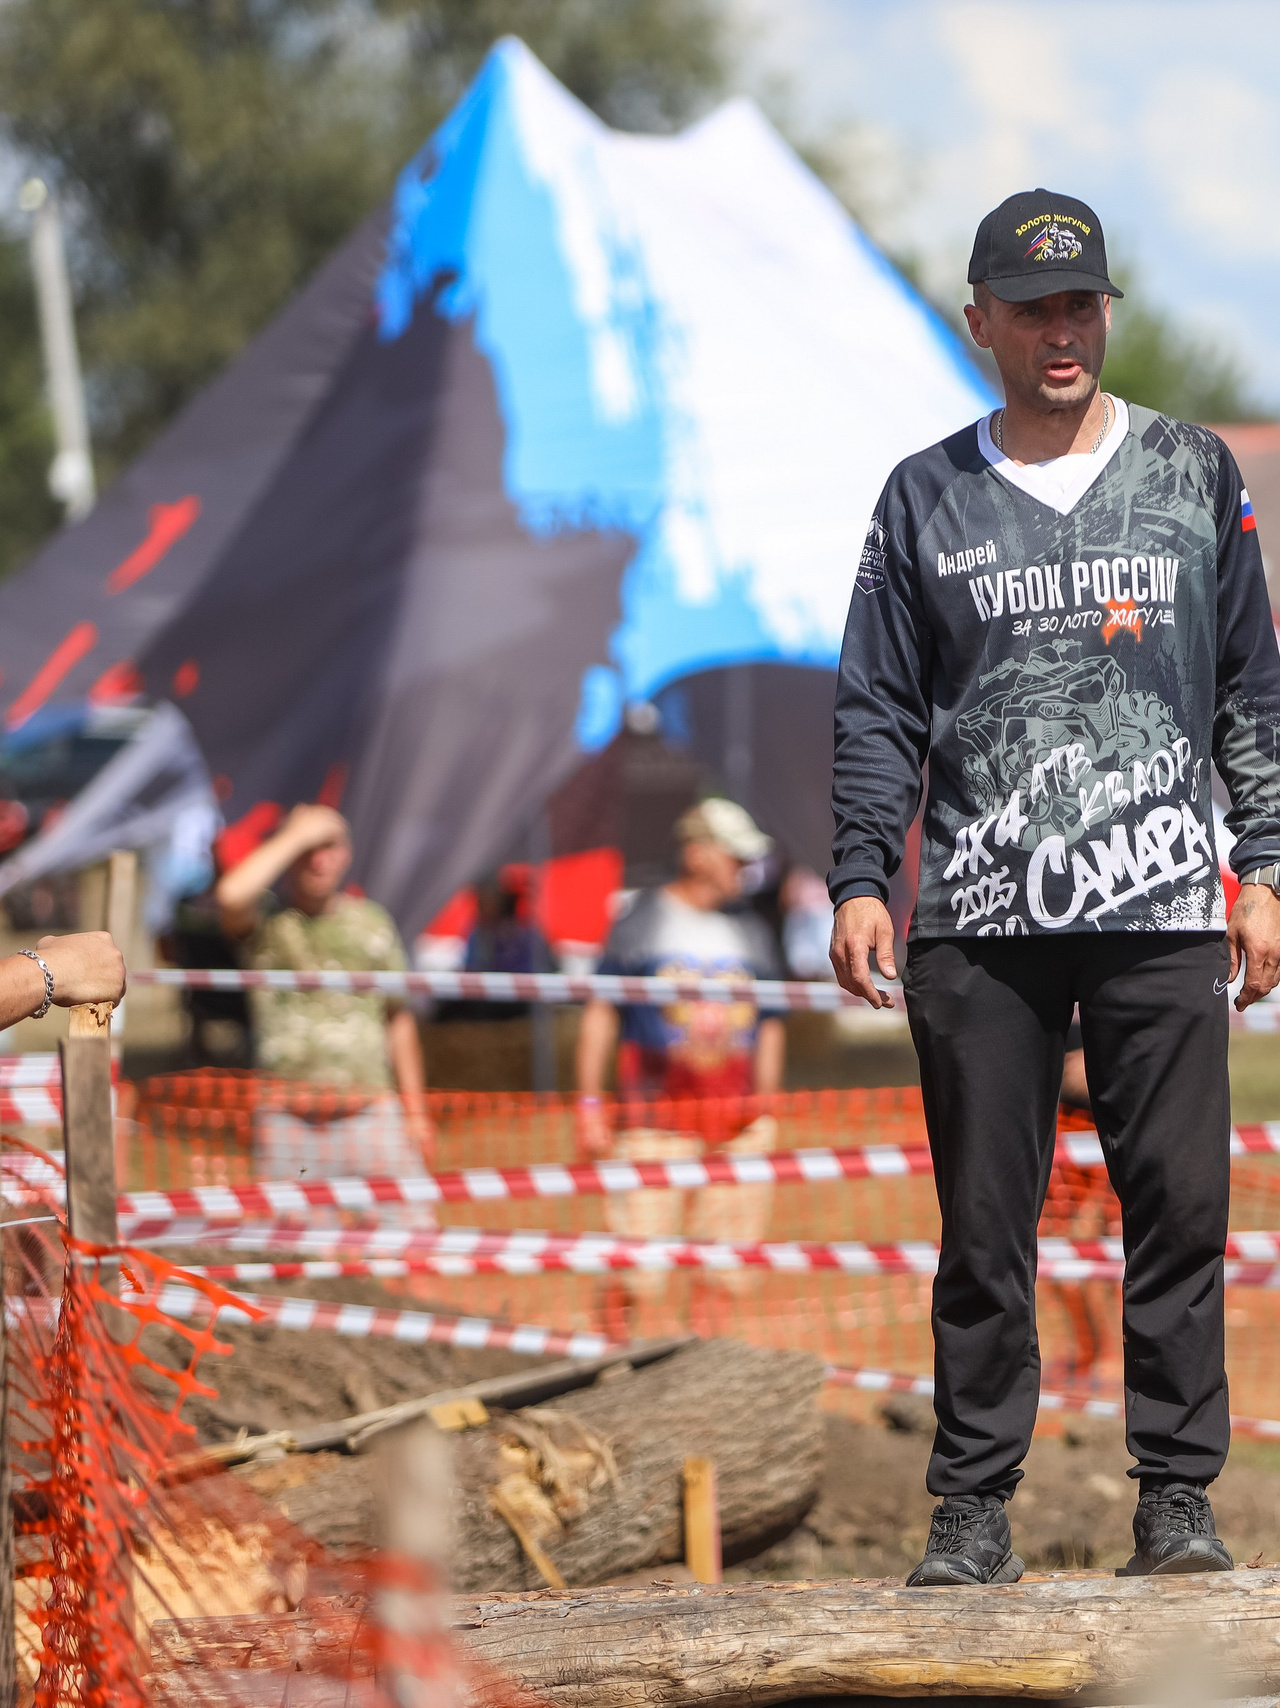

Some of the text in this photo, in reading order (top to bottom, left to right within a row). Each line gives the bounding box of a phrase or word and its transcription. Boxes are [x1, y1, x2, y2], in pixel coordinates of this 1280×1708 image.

[1015, 214, 1051, 236] ЗОЛОТО
[937, 539, 997, 577] Андрей
[968, 556, 1180, 622] КУБОК РОССИИ
[1011, 606, 1176, 637] ЗА ЗОЛОТО ЖИГУЛЕ
[1026, 800, 1214, 929] САМАРА
[950, 864, 1018, 931] 2025
